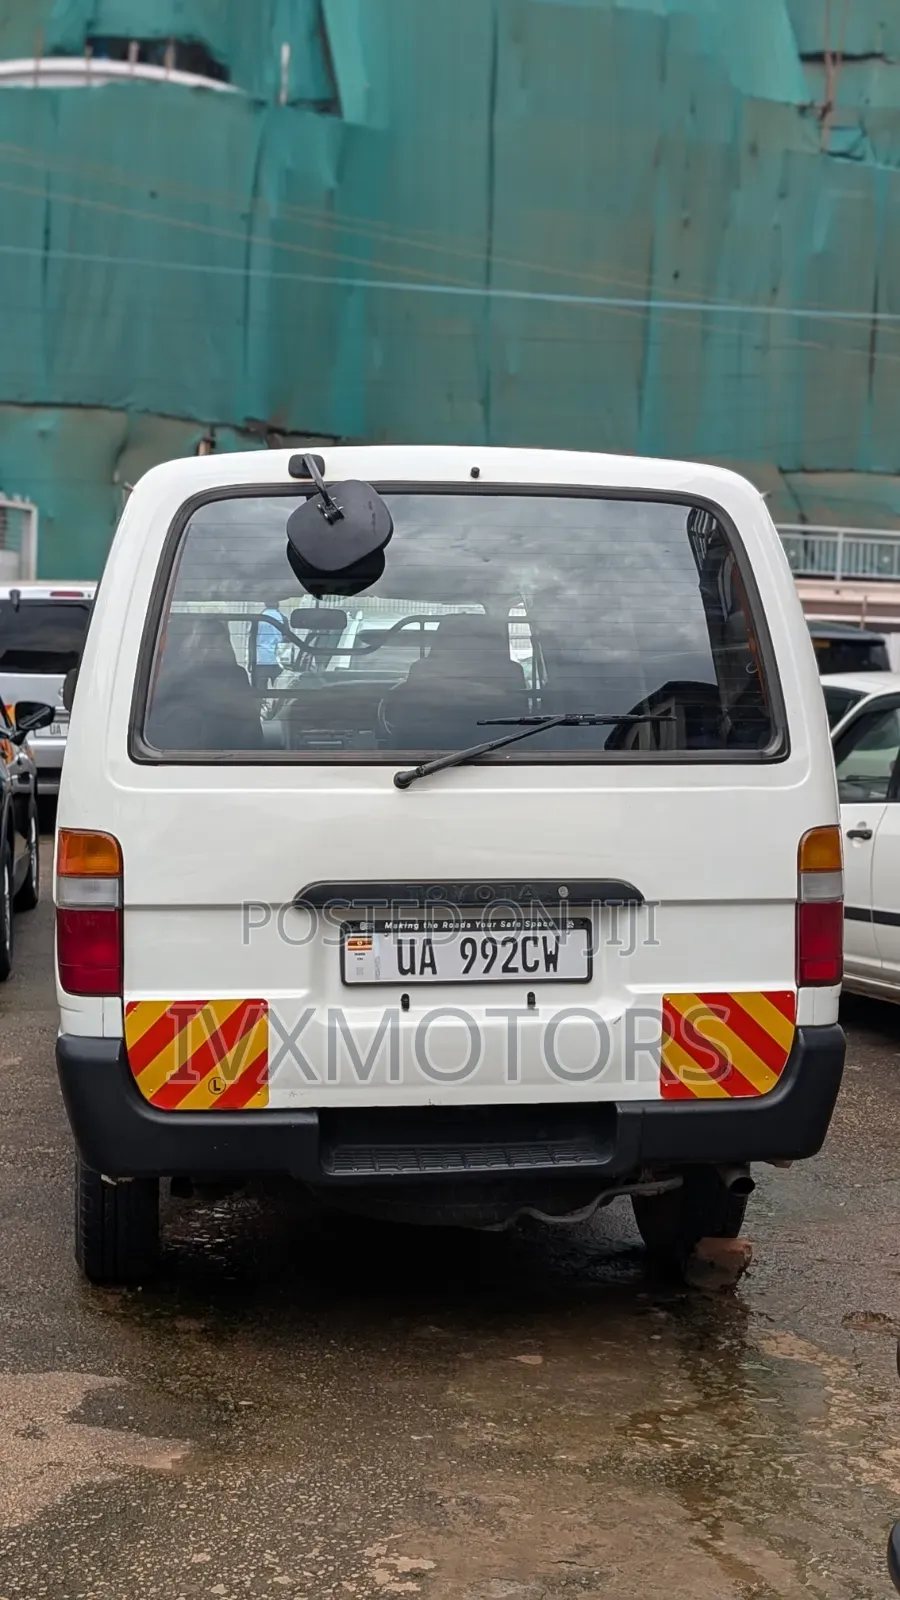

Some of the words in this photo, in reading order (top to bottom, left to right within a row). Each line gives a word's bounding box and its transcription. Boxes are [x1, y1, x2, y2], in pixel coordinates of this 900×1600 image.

[406, 884, 534, 900] TOYOTA
[384, 922, 419, 931] Making
[500, 920, 521, 928] Safe
[525, 920, 554, 929] Space
[397, 938, 437, 975] UA
[459, 936, 560, 975] 992CW
[213, 1080, 221, 1091] L
